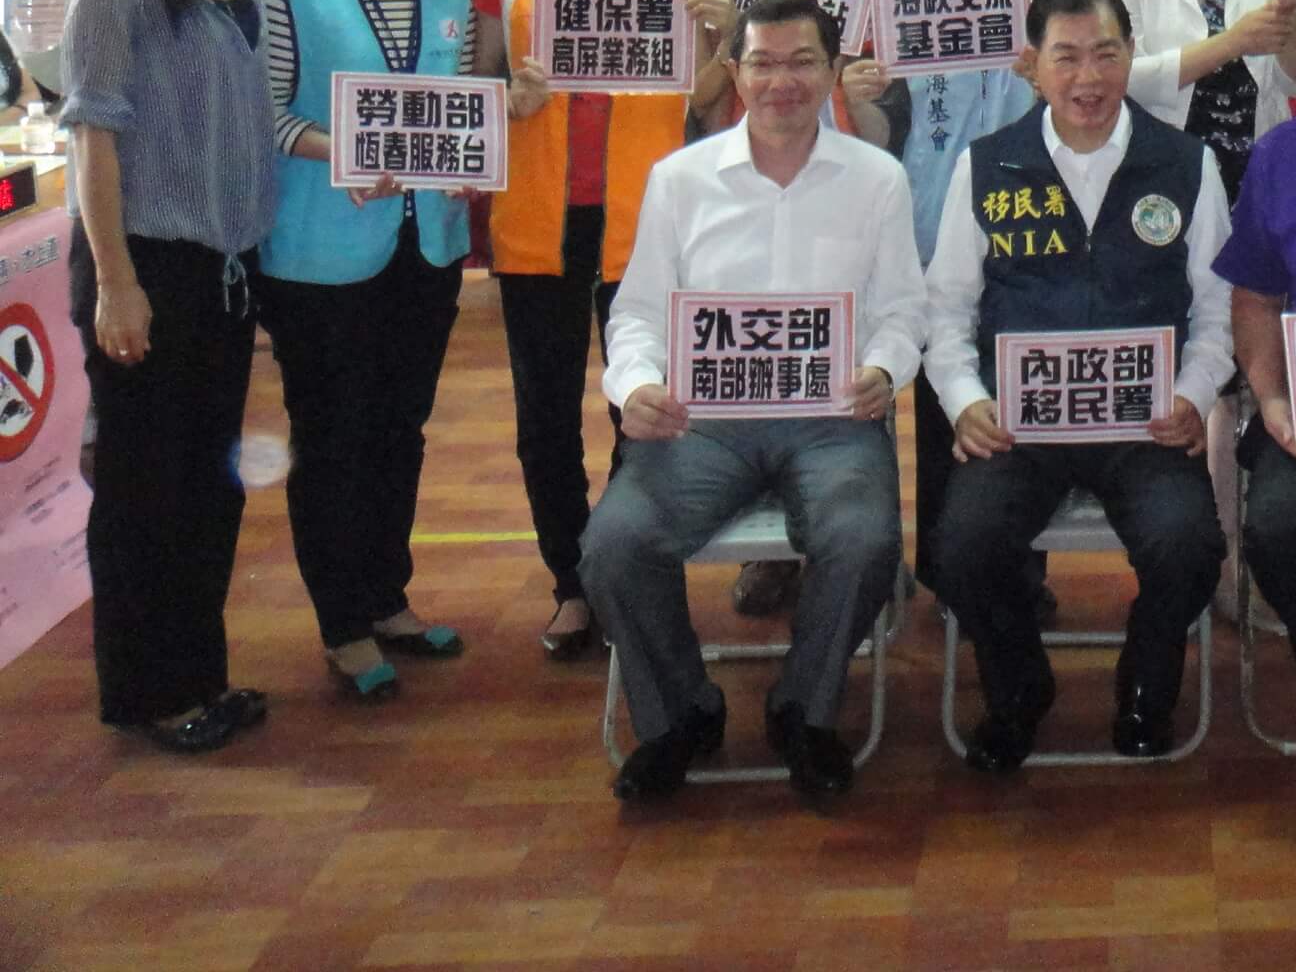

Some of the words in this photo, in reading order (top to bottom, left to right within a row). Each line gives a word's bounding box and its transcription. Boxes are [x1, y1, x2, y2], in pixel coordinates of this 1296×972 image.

[551, 37, 674, 78] 高屏業務組
[896, 13, 1013, 61] 基金會
[355, 88, 486, 130] 勞動部
[354, 131, 486, 174] 恆春服務台
[982, 185, 1067, 224] 移民署
[990, 229, 1069, 259] NIA
[692, 307, 831, 352] 外交部
[691, 355, 831, 401] 南部辦事處
[1019, 344, 1154, 386] 內政部
[1019, 384, 1154, 426] 移民署
